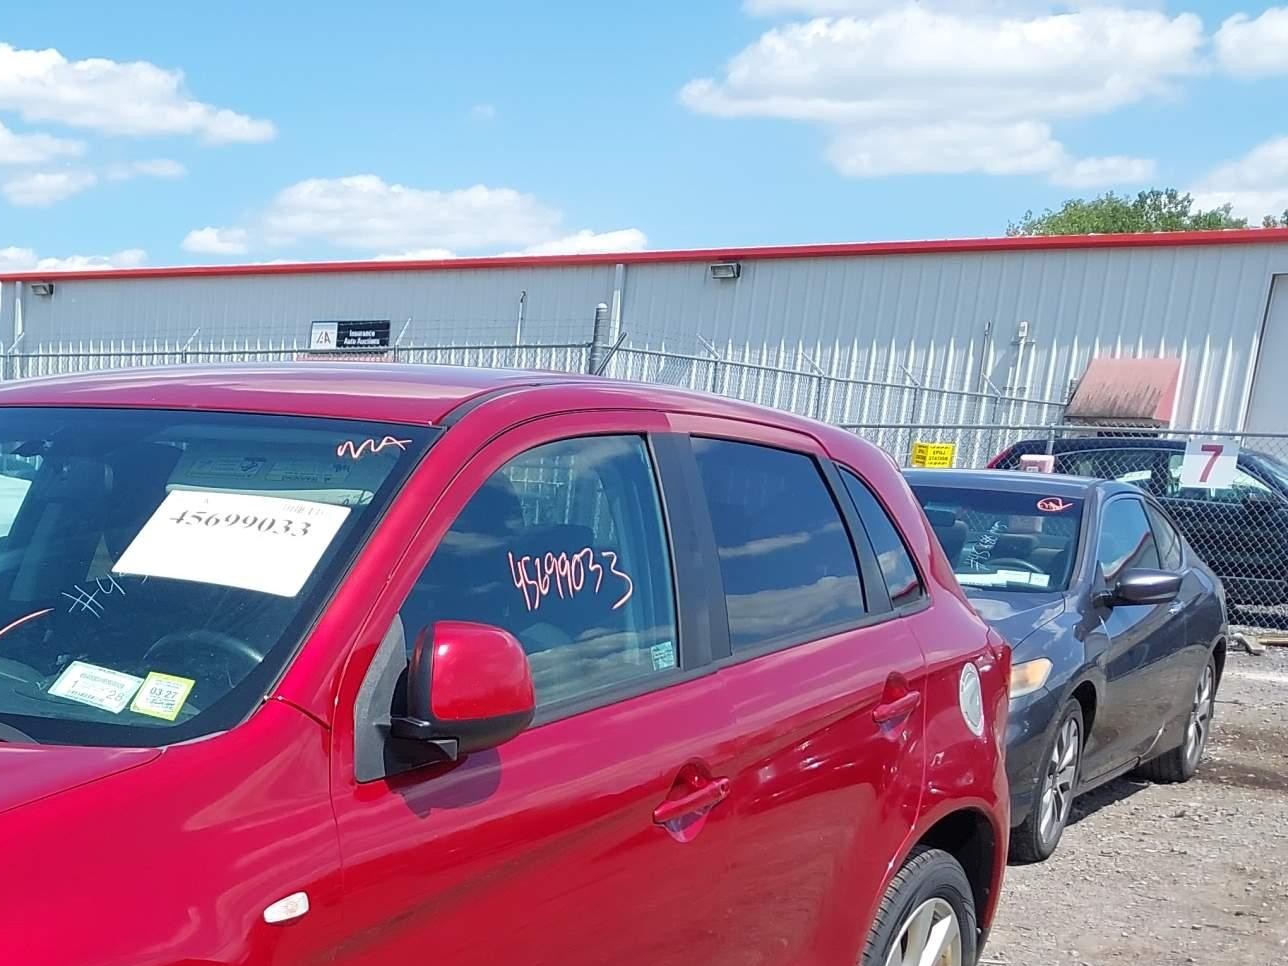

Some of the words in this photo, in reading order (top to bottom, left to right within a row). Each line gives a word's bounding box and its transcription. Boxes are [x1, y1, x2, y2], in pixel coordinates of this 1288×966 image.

[344, 337, 357, 345] Auto
[357, 337, 380, 345] Auctions
[349, 329, 376, 337] Insurance
[1201, 445, 1224, 482] 7
[168, 509, 312, 537] 45699033
[508, 547, 634, 613] 45699033
